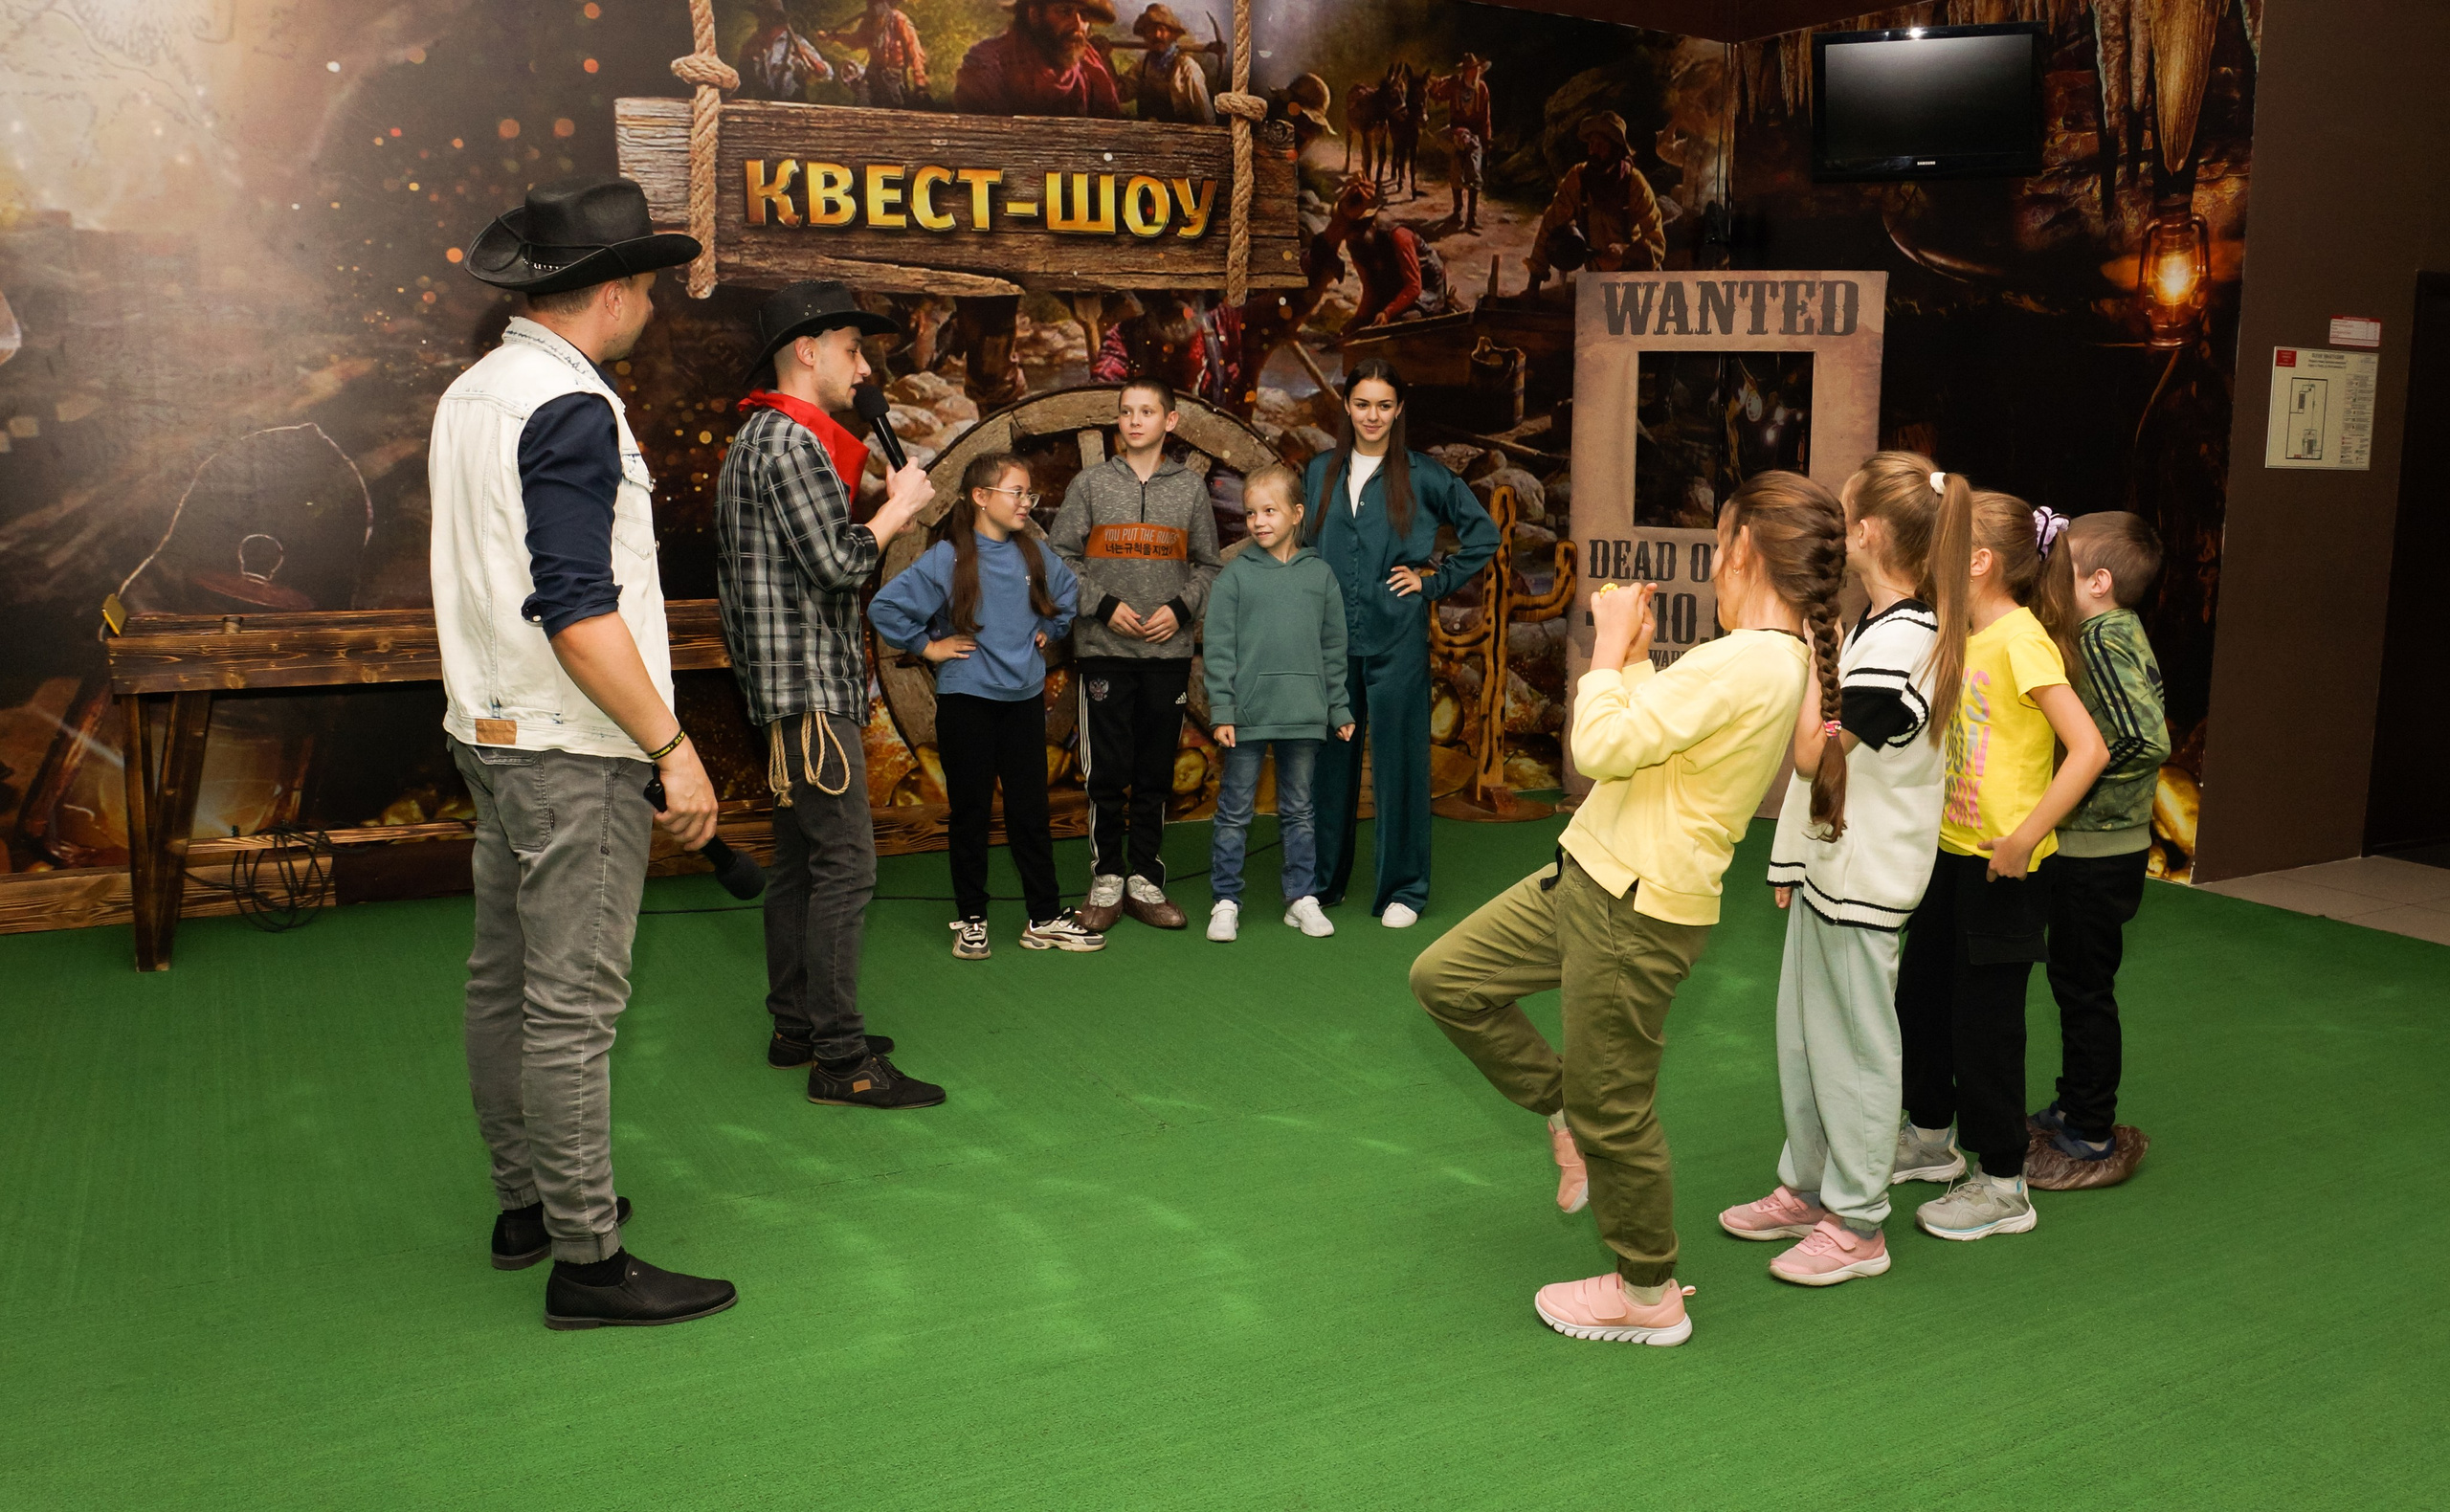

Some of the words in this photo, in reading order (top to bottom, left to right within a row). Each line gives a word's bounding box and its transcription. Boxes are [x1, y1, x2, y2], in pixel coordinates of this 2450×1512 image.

[744, 158, 1218, 239] КВЕСТ-ШОУ
[1600, 279, 1860, 336] WANTED
[1104, 528, 1120, 542] YOU
[1122, 527, 1139, 542] PUT
[1140, 527, 1156, 543] THE
[1588, 539, 1677, 581] DEAD
[1690, 543, 1719, 582] O
